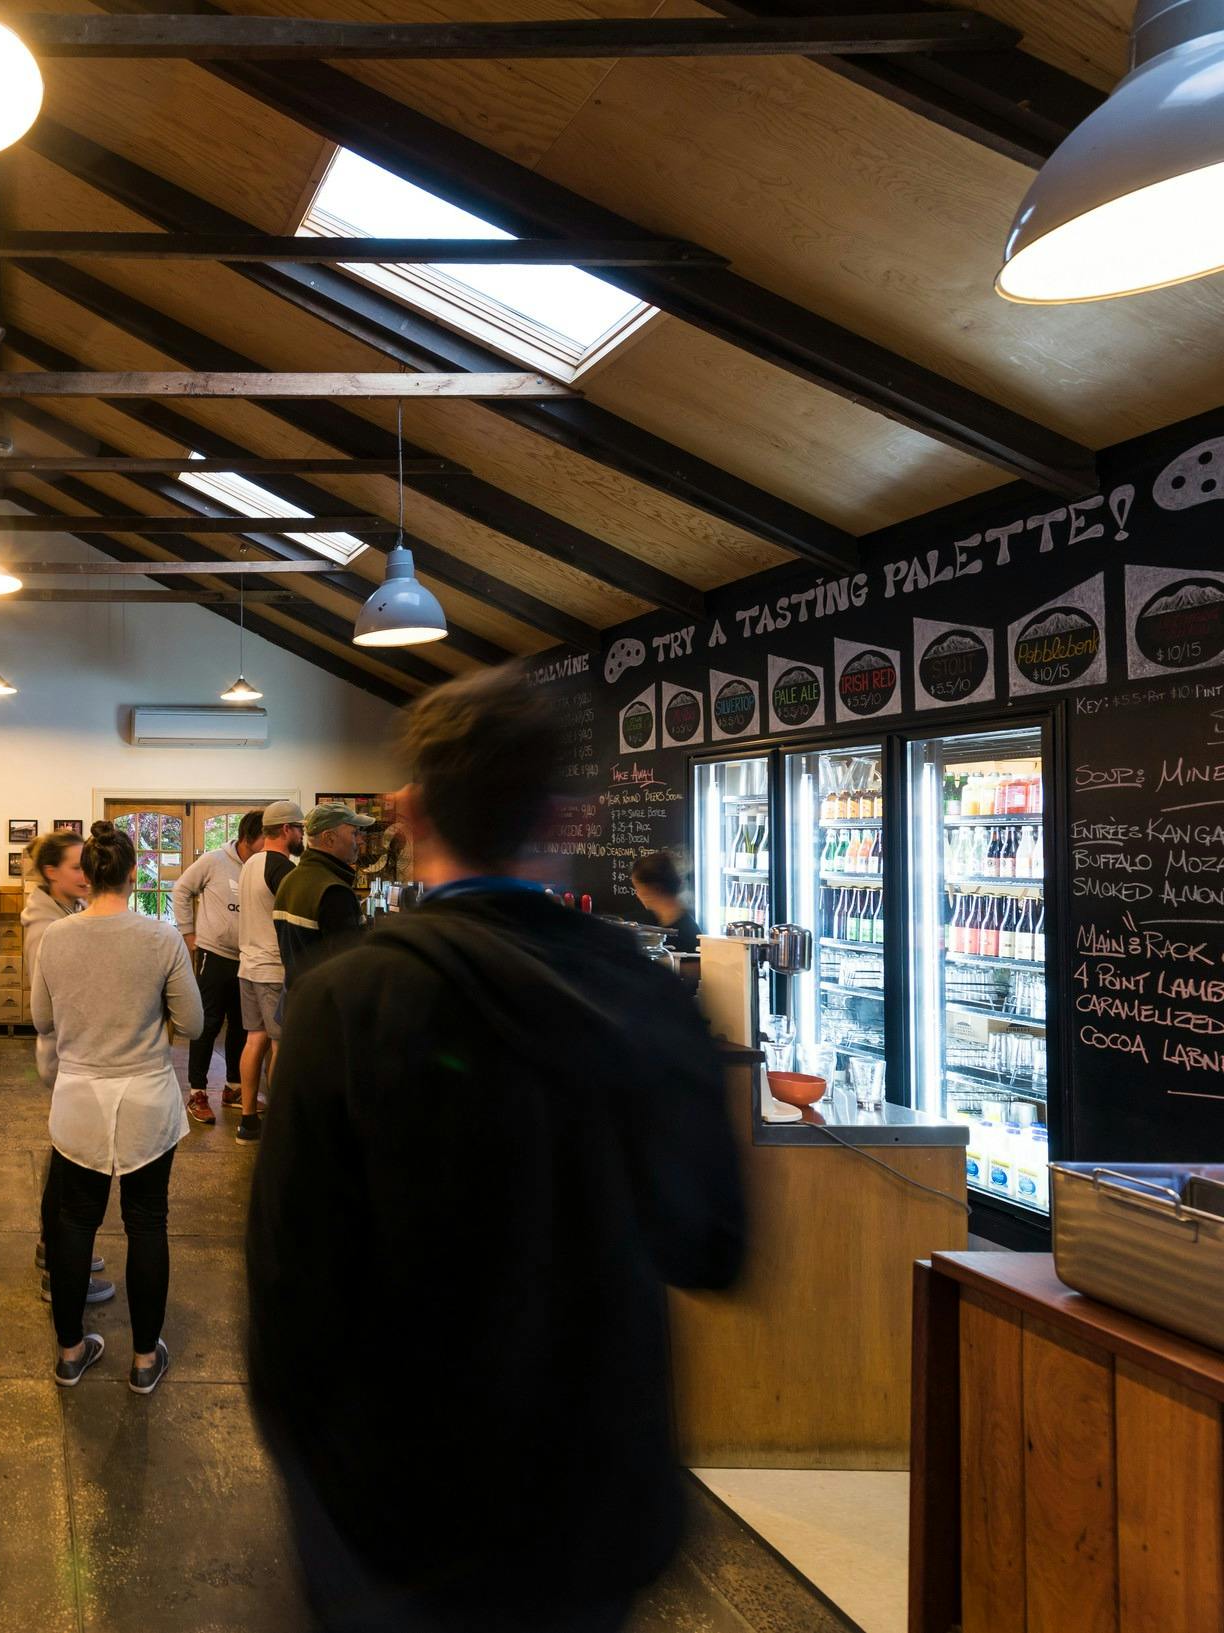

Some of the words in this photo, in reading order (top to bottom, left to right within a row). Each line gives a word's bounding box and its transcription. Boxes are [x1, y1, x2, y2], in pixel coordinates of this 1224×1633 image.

[653, 626, 696, 662] TRY
[708, 620, 727, 648] A
[883, 484, 1136, 598] PALETTE!
[1157, 641, 1202, 664] $10/15
[841, 671, 869, 694] IRISH
[872, 667, 896, 689] RED
[1032, 664, 1070, 681] $10/15
[716, 693, 756, 715] SILVERTOP
[774, 686, 797, 705] PALE
[800, 682, 819, 701] ALE
[1076, 696, 1109, 715] KEY:
[610, 762, 629, 782] TAKE
[631, 761, 655, 784] AWAY
[1072, 848, 1152, 873] BUFFALO
[1072, 876, 1152, 901] SMOKED
[1143, 930, 1215, 966] RACK
[1073, 960, 1090, 989] 4
[1157, 969, 1224, 1004] LAMB
[1075, 994, 1224, 1036] CARAMELIZED
[1080, 1025, 1150, 1065] COCOA
[1163, 1038, 1224, 1072] LABN
